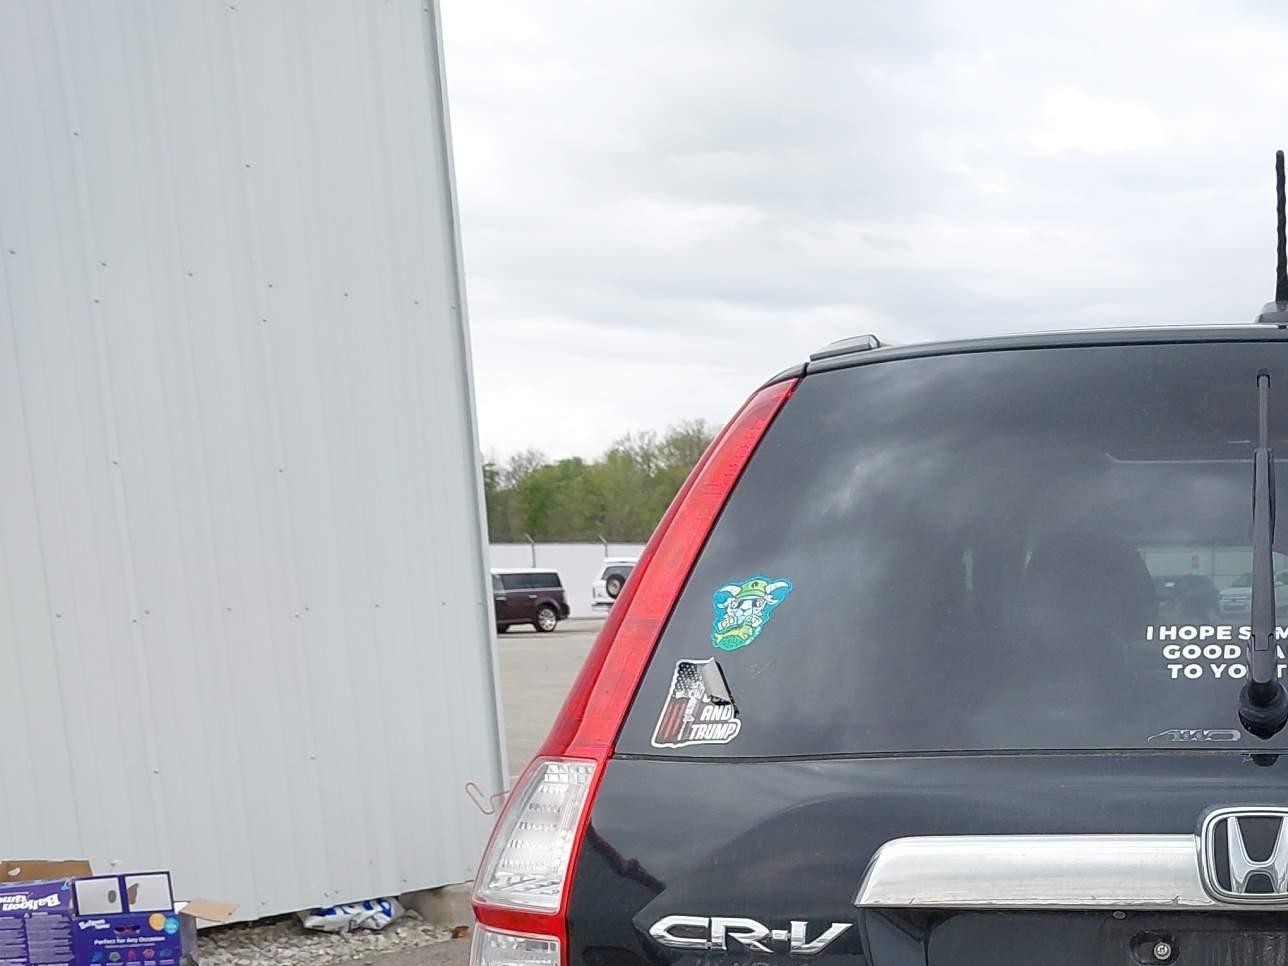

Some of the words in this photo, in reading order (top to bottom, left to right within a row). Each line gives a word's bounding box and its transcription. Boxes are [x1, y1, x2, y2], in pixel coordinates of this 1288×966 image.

[1146, 626, 1153, 640] I
[1159, 626, 1232, 640] HOPE
[1163, 645, 1241, 659] GOOD
[1168, 664, 1202, 679] TO
[1211, 664, 1249, 679] YO
[700, 705, 732, 721] AND
[689, 724, 737, 740] TRUMP
[649, 915, 854, 954] CR-V
